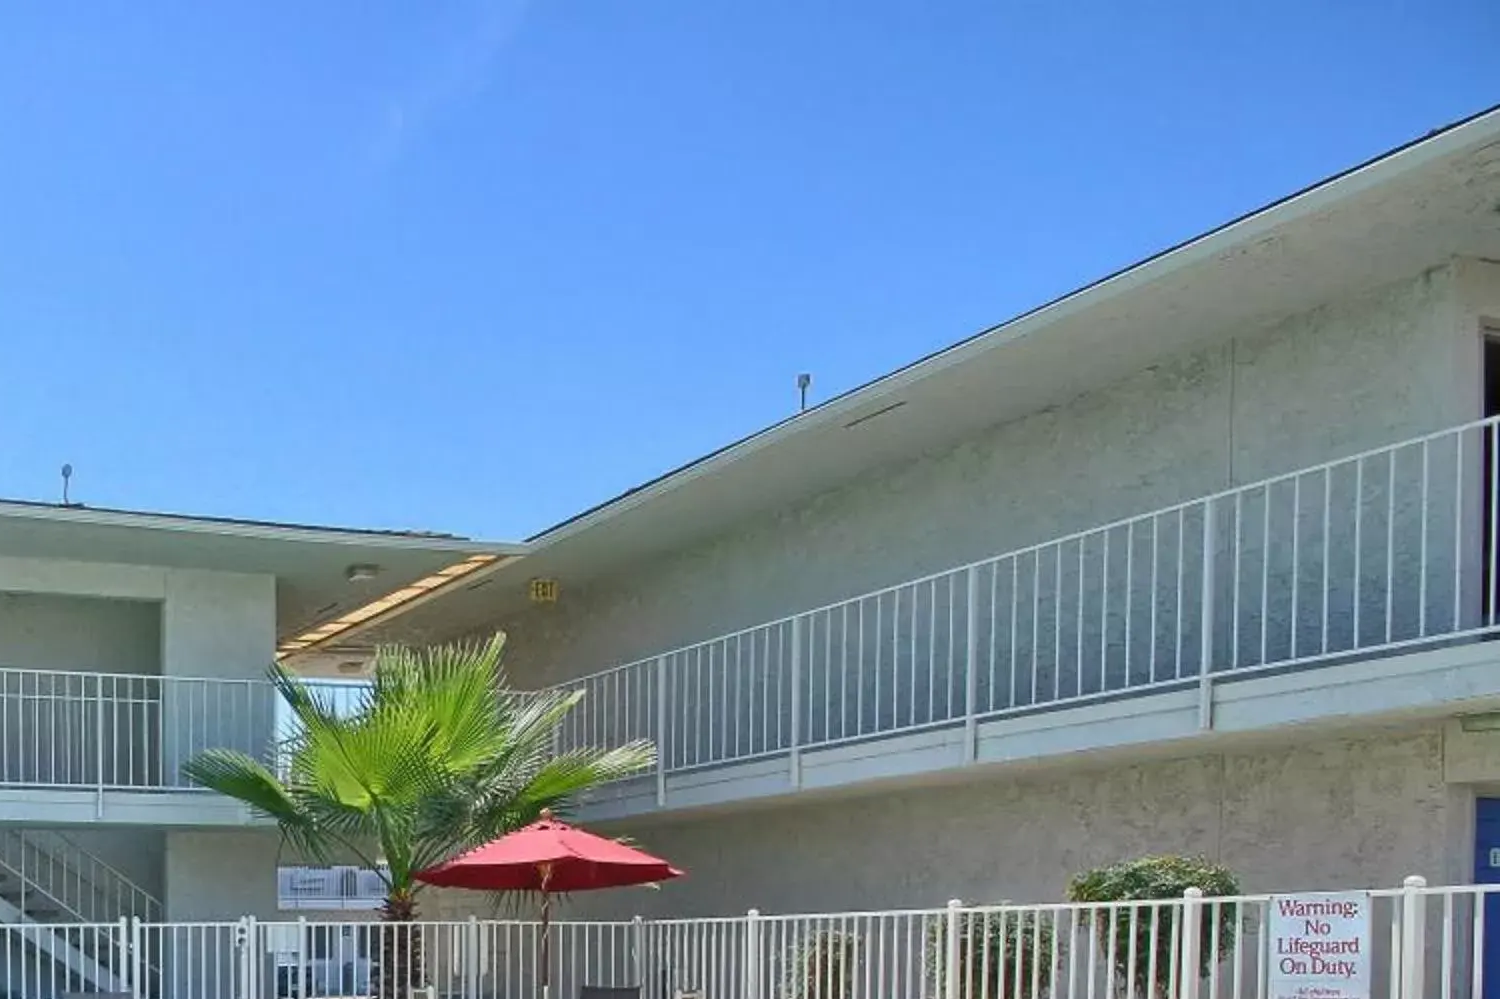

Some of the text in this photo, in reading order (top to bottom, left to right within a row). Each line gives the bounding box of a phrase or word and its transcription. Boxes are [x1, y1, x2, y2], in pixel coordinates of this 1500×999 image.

[1277, 899, 1359, 918] Warning:
[1304, 920, 1331, 936] No
[1277, 937, 1360, 958] Lifeguard
[1280, 956, 1357, 978] On Duty.
